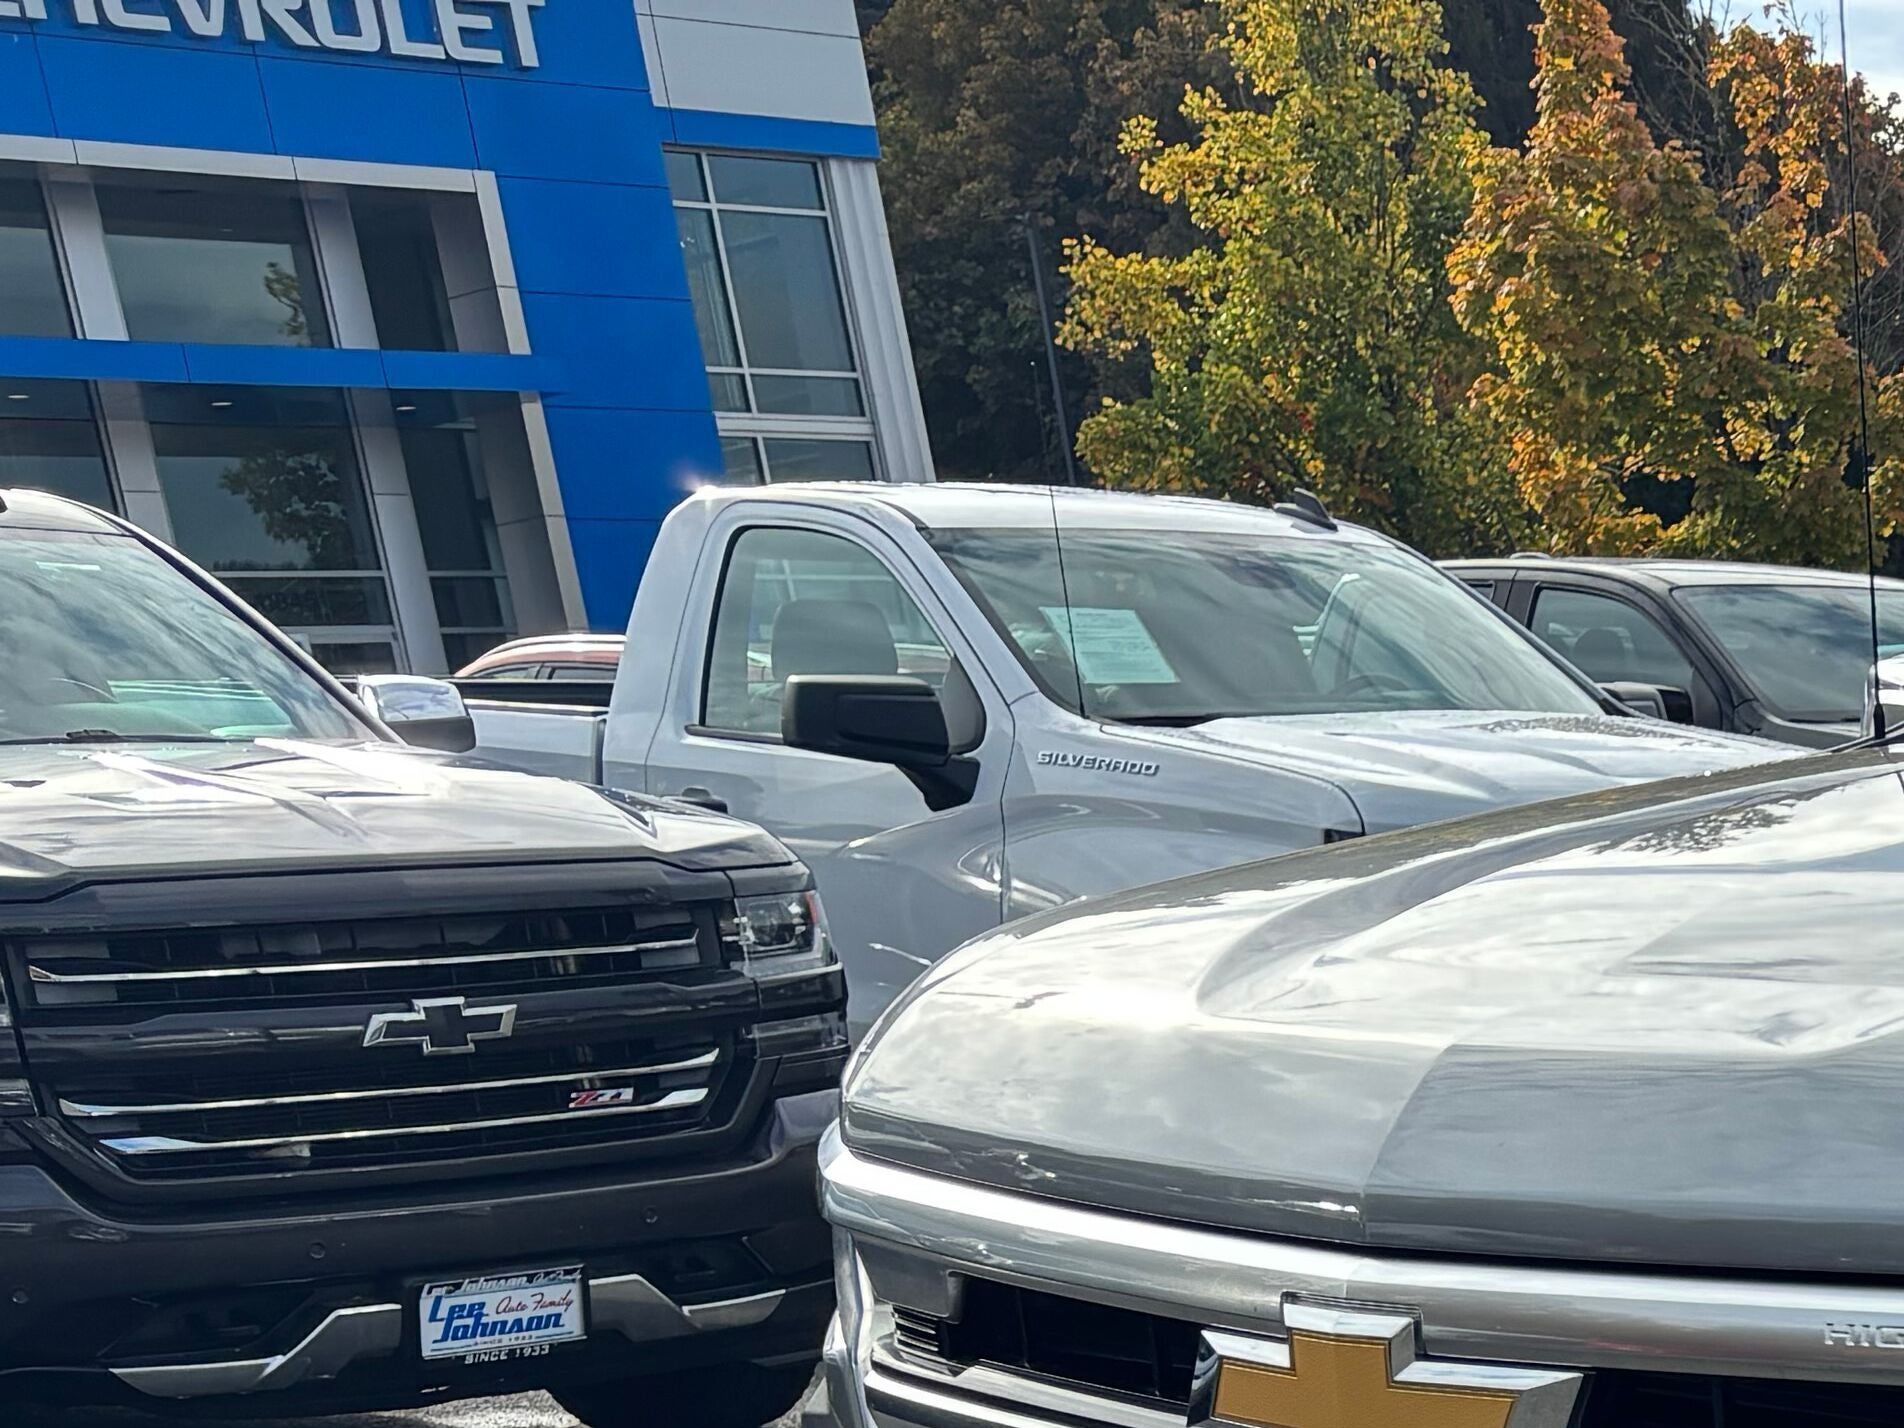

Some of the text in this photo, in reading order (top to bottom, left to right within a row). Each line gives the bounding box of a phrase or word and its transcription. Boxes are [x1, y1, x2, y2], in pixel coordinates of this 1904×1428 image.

[1037, 750, 1160, 777] SILVERADO
[568, 1087, 634, 1109] Z71
[428, 1289, 574, 1323] Lee Auto Family
[432, 1312, 566, 1344] Johnson
[464, 1345, 550, 1364] SINCE 1933
